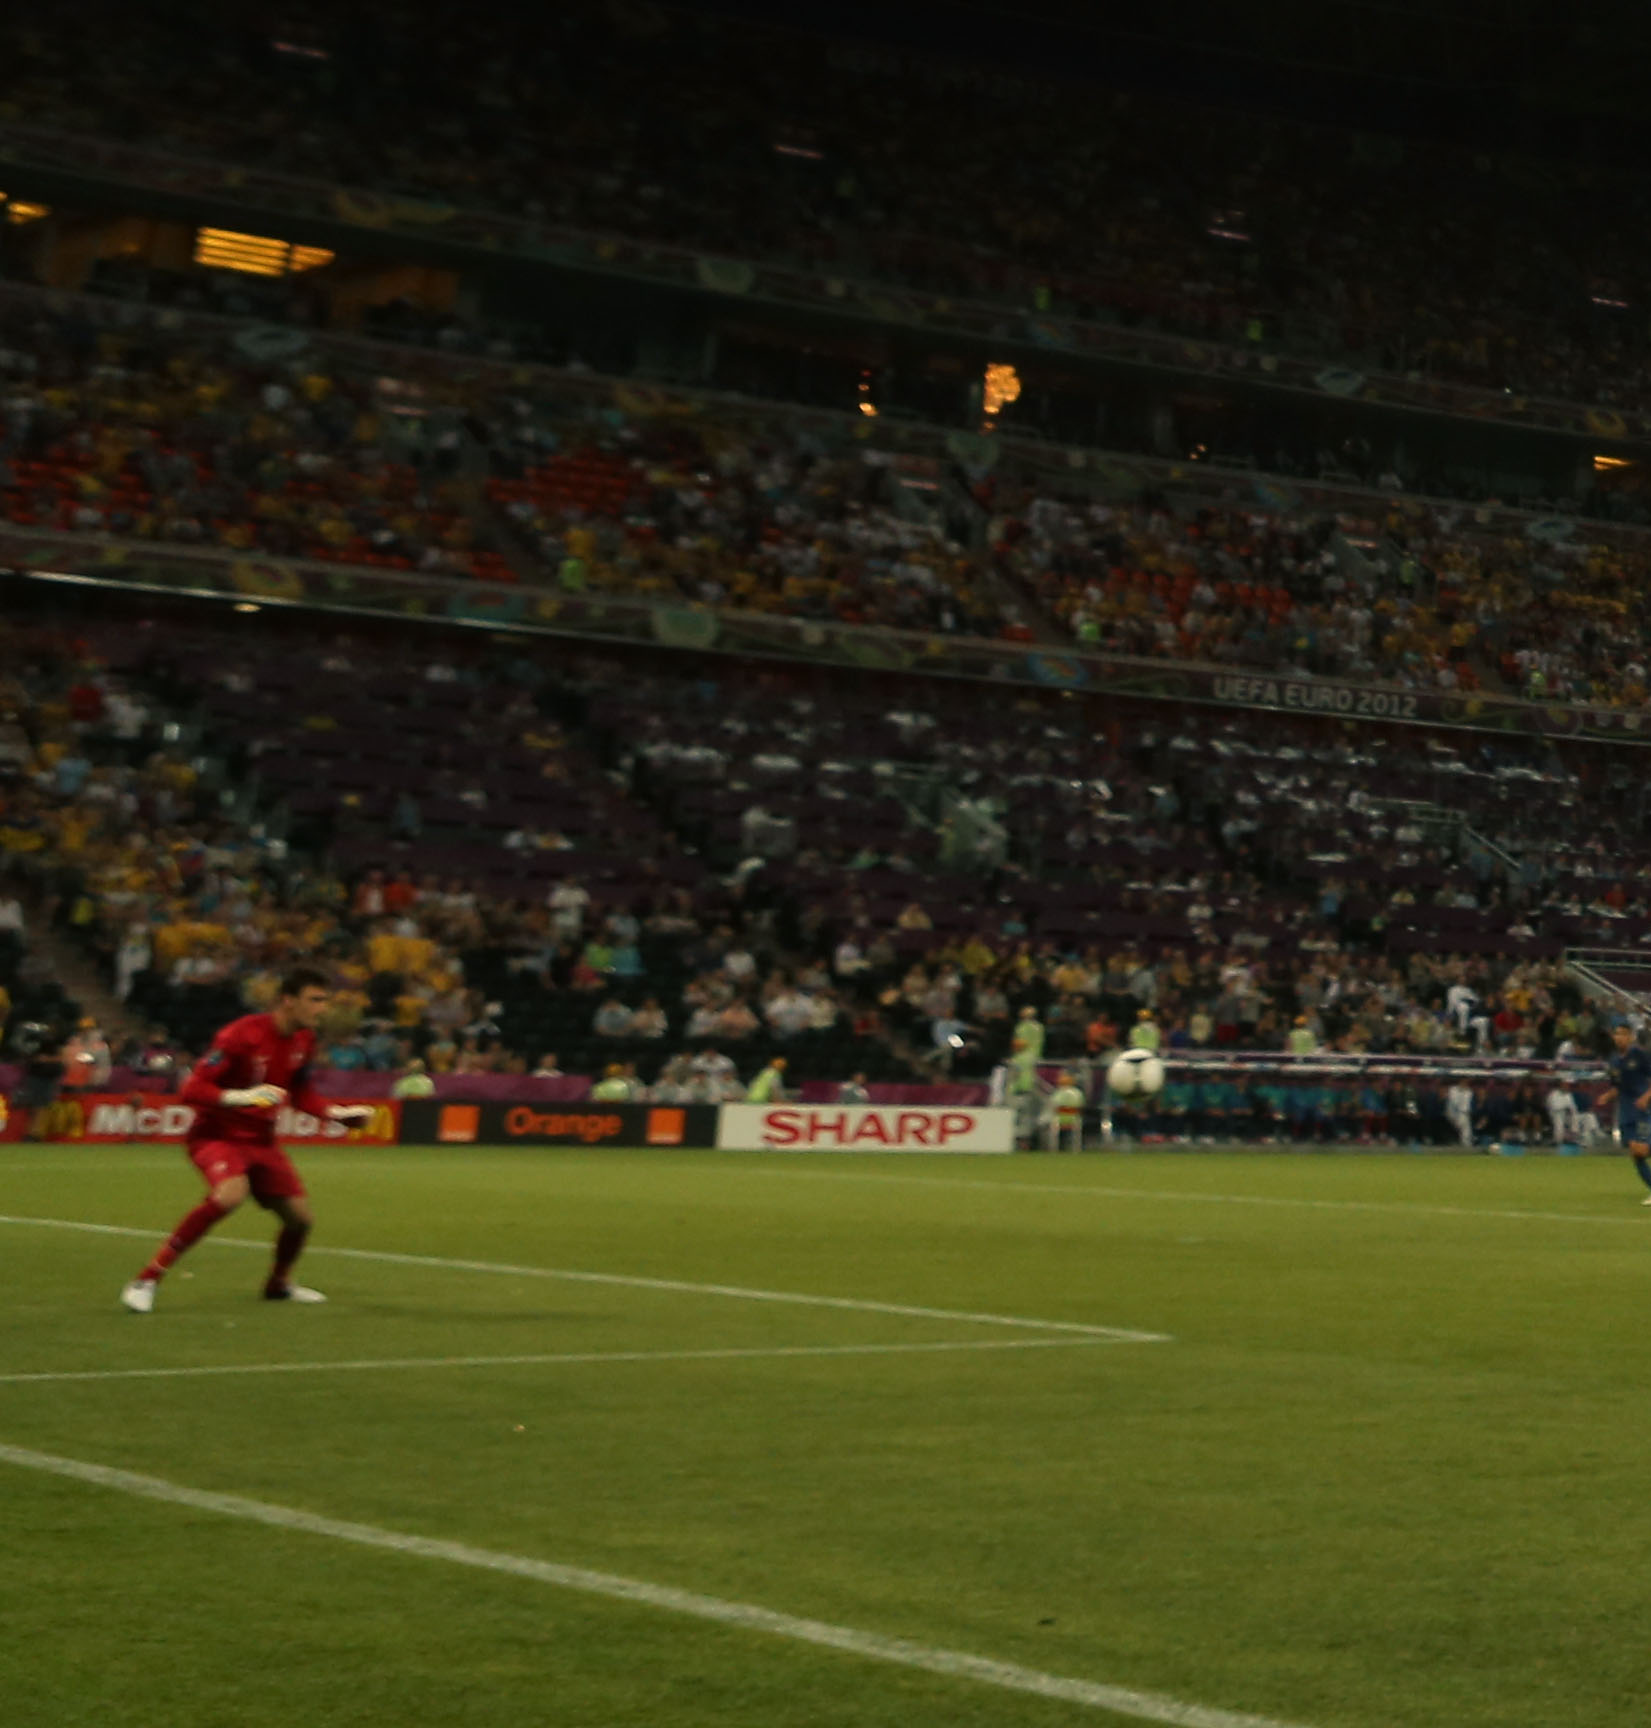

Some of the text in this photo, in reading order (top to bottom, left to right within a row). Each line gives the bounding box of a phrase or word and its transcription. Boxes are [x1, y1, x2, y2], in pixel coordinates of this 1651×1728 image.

[1213, 676, 1417, 716] UEFA EURO 2012
[505, 1106, 623, 1143] Orange
[763, 1111, 975, 1145] SHARP
